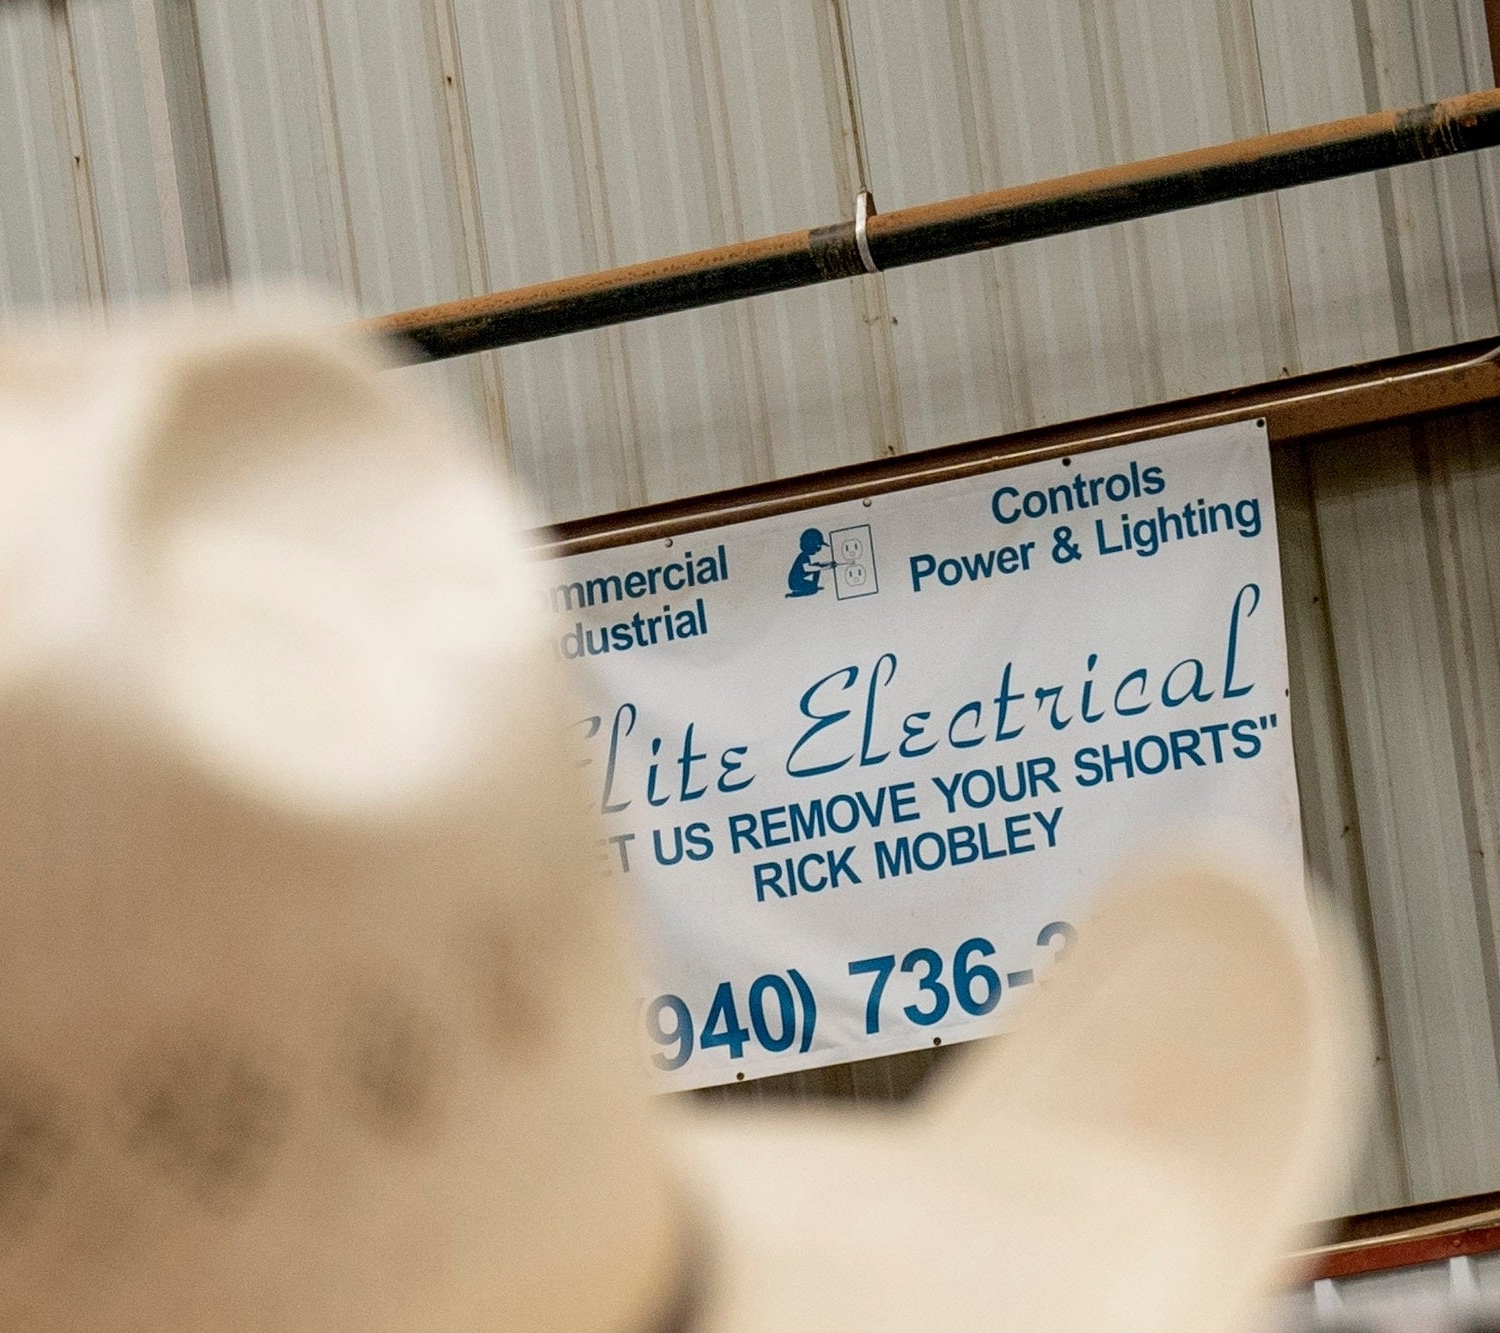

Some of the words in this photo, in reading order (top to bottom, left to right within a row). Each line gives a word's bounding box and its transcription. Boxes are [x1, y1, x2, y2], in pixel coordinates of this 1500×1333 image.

[990, 460, 1167, 527] Controls
[550, 544, 730, 613] mmercial
[908, 535, 1035, 592] Power
[1052, 526, 1083, 562] &
[1097, 496, 1262, 558] Lighting
[560, 597, 709, 661] dustrial
[785, 582, 1262, 779] Electrical
[653, 822, 714, 866] US
[729, 781, 920, 855] REMOVE
[932, 755, 1060, 815] YOUR
[1075, 712, 1279, 788] SHORTS"
[753, 844, 861, 902] RICK
[874, 806, 1066, 877] MOBLEY
[638, 968, 818, 1072] 940)
